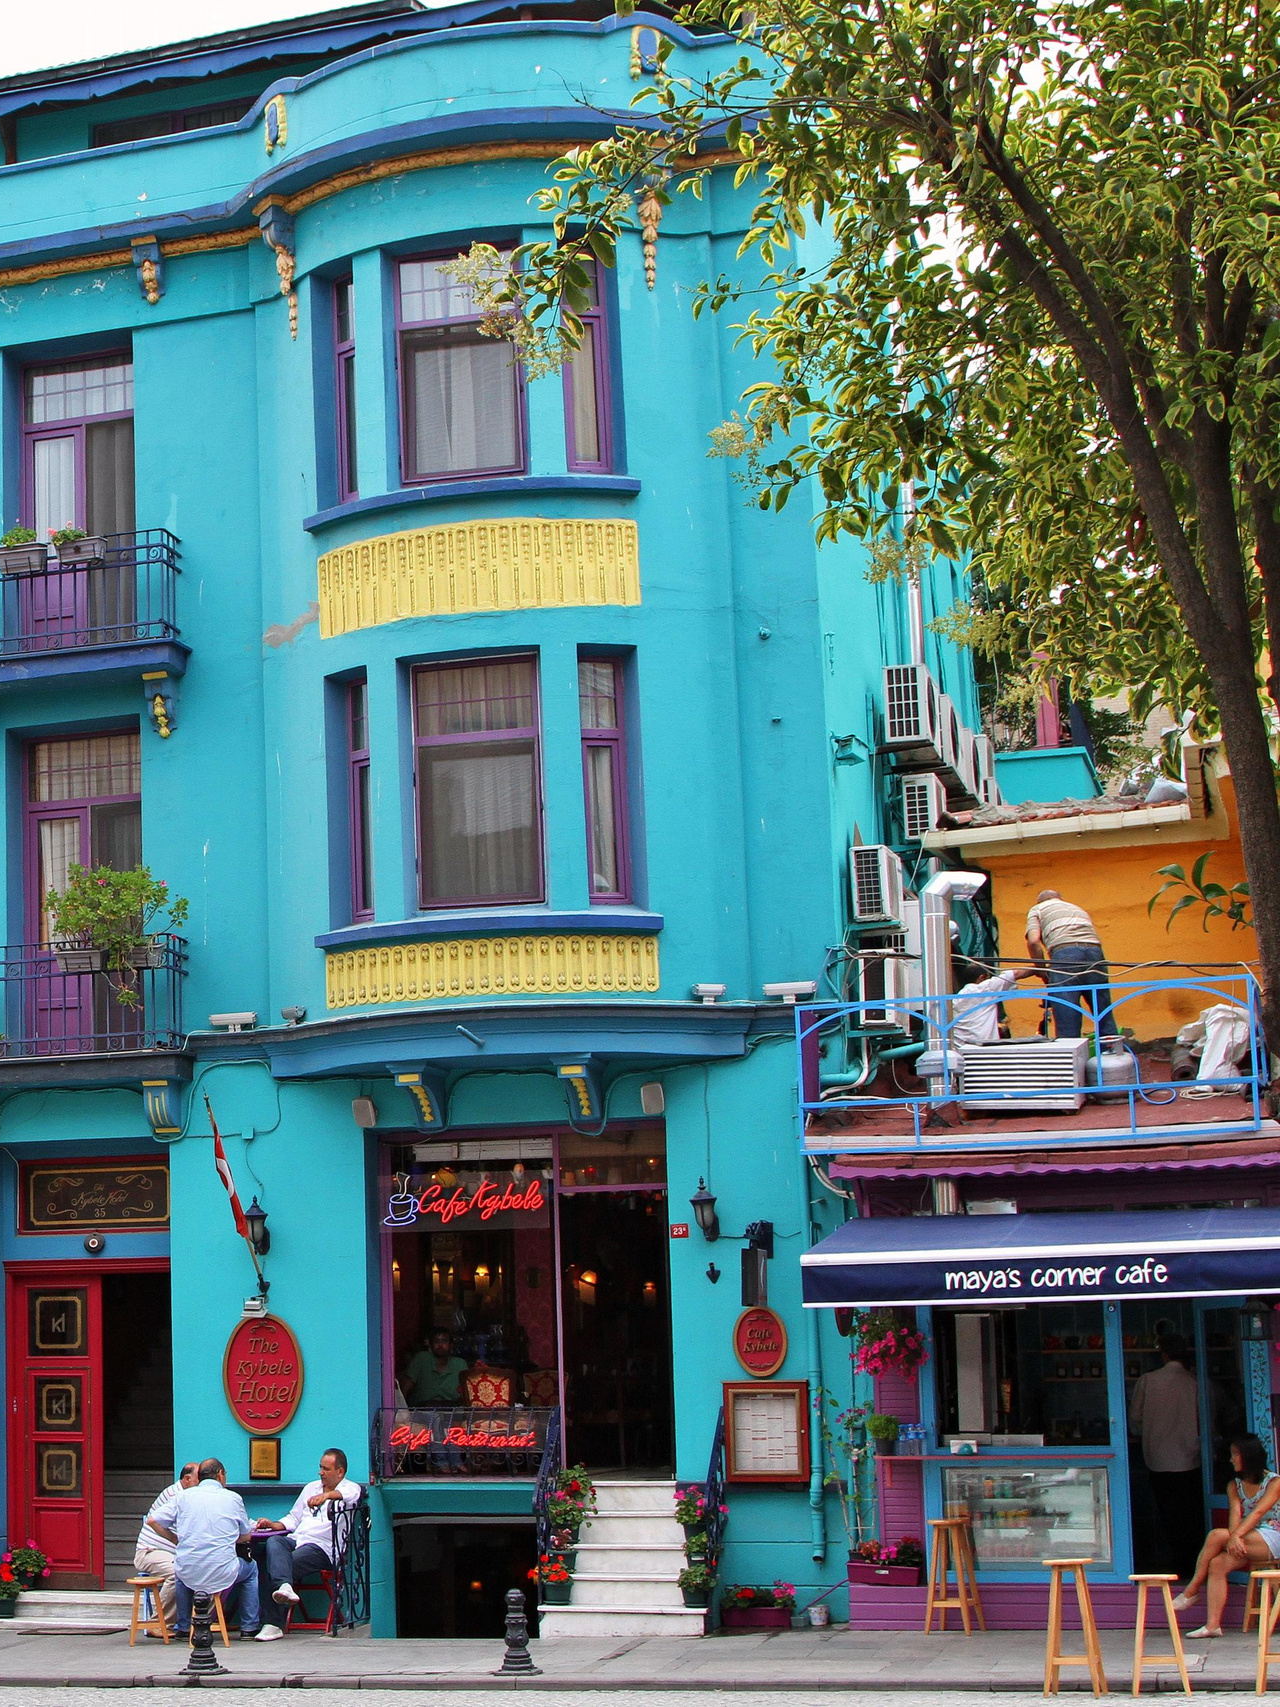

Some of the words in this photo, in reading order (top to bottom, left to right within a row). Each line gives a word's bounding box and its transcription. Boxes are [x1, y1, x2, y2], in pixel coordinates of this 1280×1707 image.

[419, 1184, 469, 1223] Cafe
[469, 1180, 544, 1220] Kybele
[94, 1208, 106, 1218] 35
[945, 1267, 1021, 1293] maya's
[1031, 1266, 1106, 1288] corner
[1115, 1257, 1168, 1285] cafe
[746, 1328, 771, 1340] Cafe
[248, 1338, 279, 1354] The
[743, 1341, 778, 1354] Kybele
[235, 1360, 293, 1379] Kybele
[235, 1380, 298, 1403] Hotel
